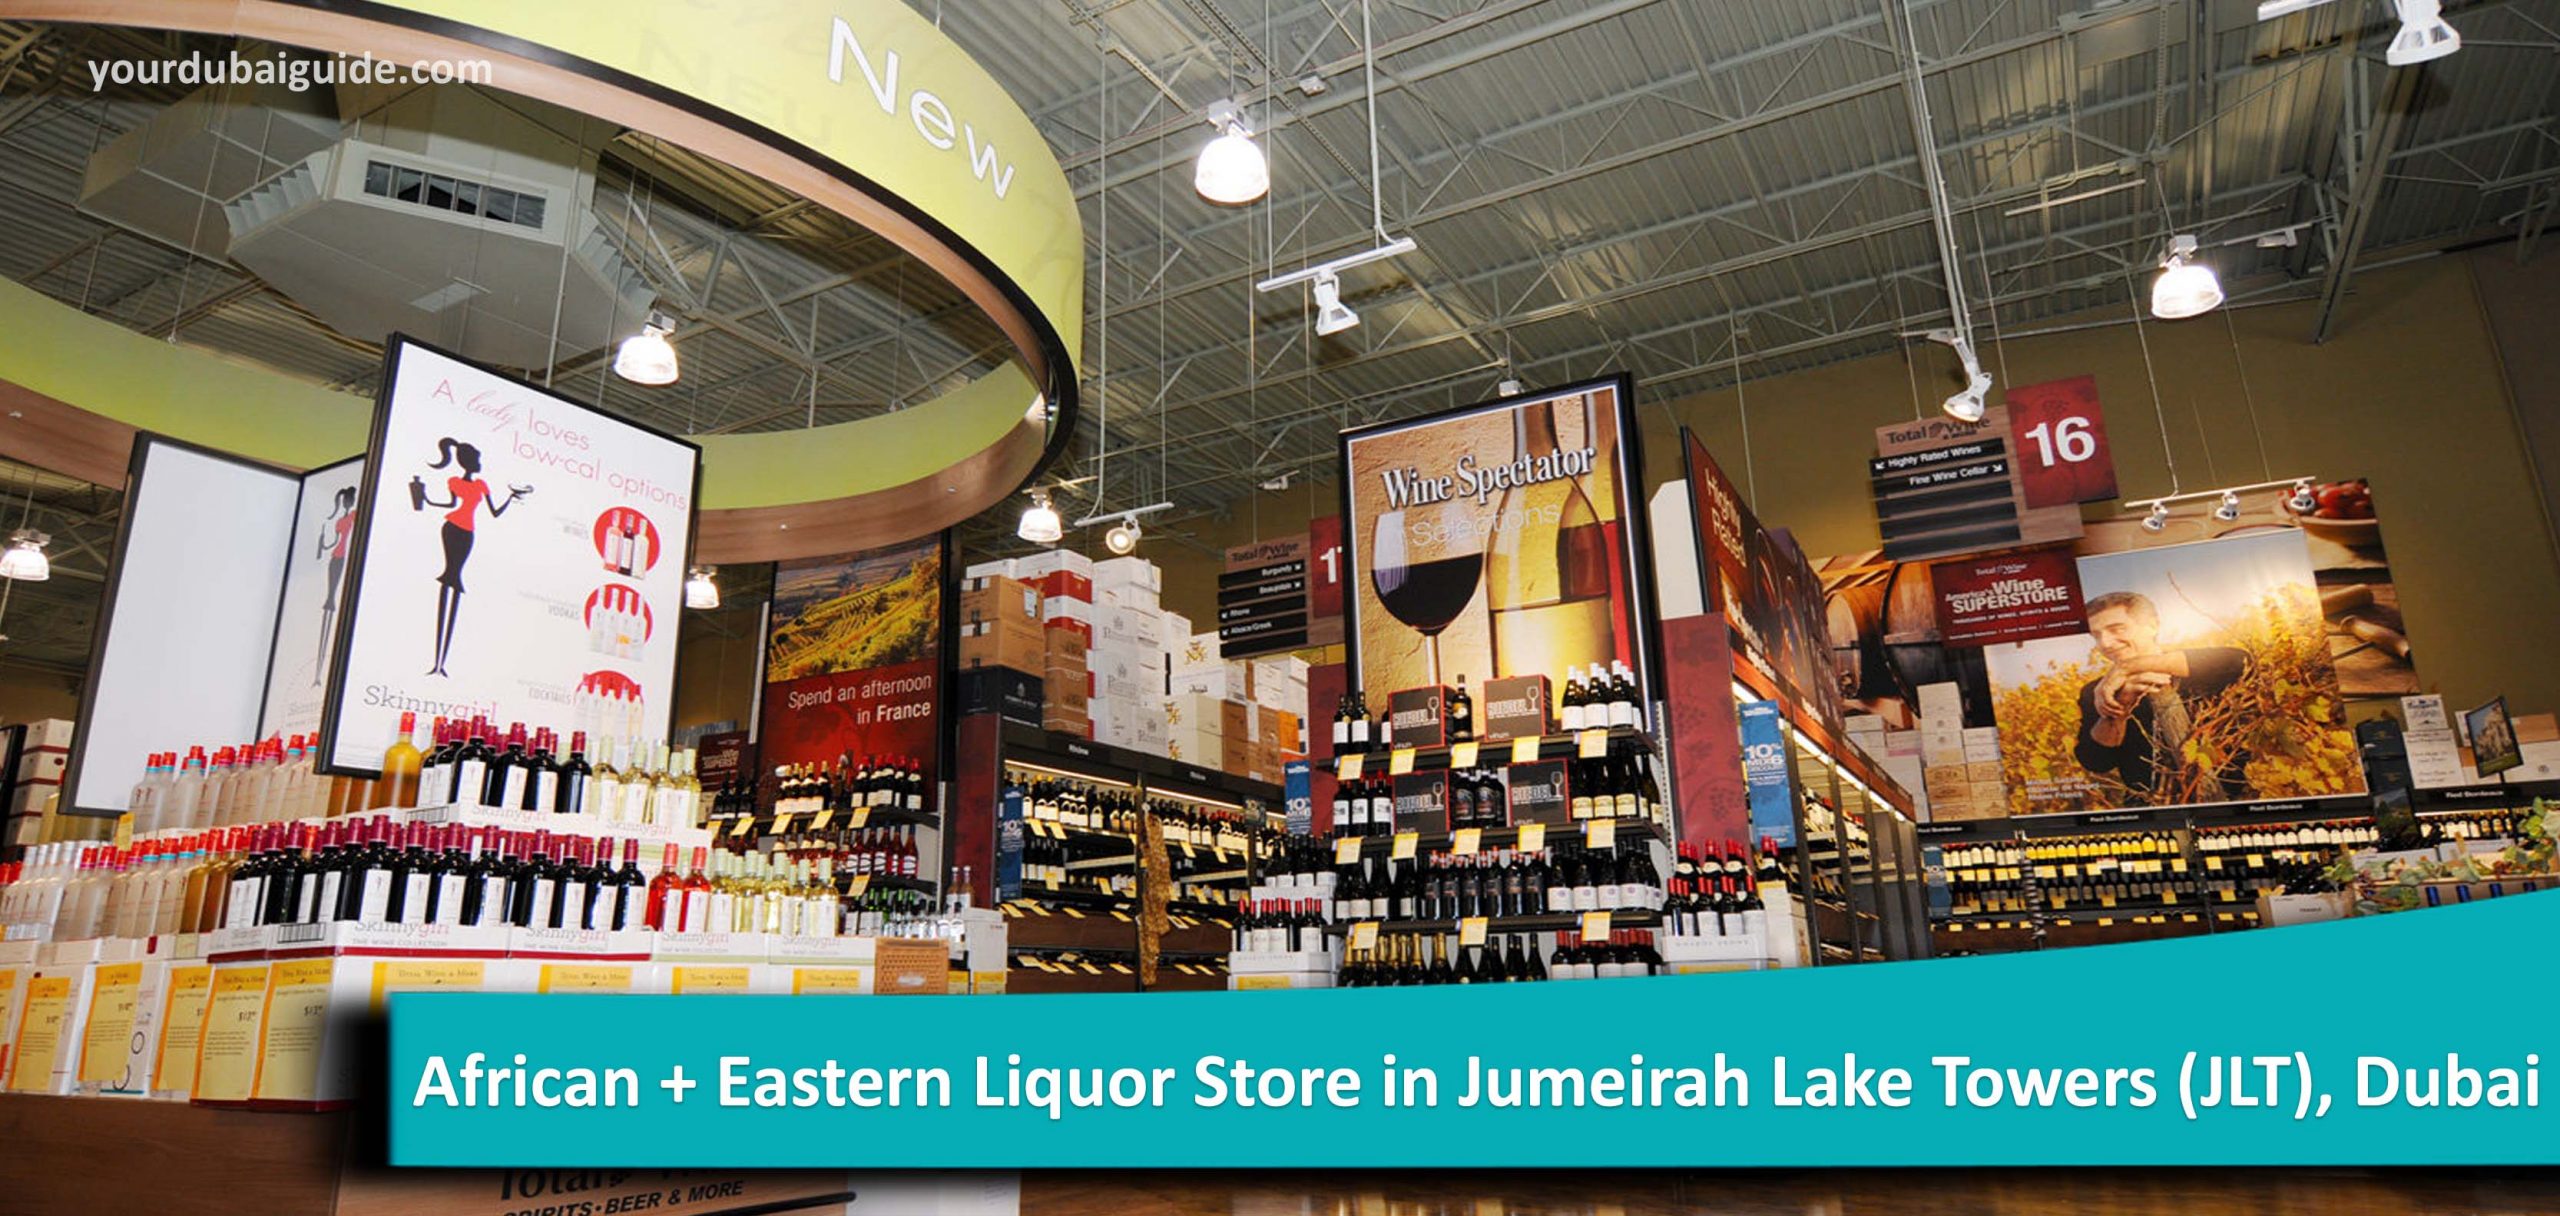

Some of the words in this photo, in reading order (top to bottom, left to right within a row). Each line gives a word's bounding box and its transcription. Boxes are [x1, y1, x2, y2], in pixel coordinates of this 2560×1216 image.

[827, 15, 1016, 201] New
[431, 378, 455, 403] A
[467, 388, 517, 432] lady
[528, 408, 590, 450] loves
[1887, 426, 1928, 444] Total
[2024, 415, 2096, 467] 16
[513, 431, 600, 481] low-cal
[609, 468, 687, 511] options
[1887, 455, 1918, 469] Highly
[1920, 450, 1949, 463] Rated
[1950, 445, 1982, 457] Wines
[1382, 466, 1452, 510] Wine
[1457, 446, 1597, 506] Spectator
[1909, 473, 1931, 486] Fine
[1932, 469, 1957, 483] Wine
[1960, 464, 1989, 478] Cellar
[1411, 503, 1561, 547] Selections
[1952, 586, 2069, 614] SUPERSTORE
[1991, 578, 2045, 594] Wine
[363, 684, 498, 719] Skinnygirl
[787, 687, 832, 710] Spend
[837, 685, 856, 702] an
[861, 673, 932, 699] afternoon
[857, 708, 870, 725] in
[876, 701, 931, 724] France
[667, 1189, 681, 1206] &
[687, 1180, 744, 1202] MORE
